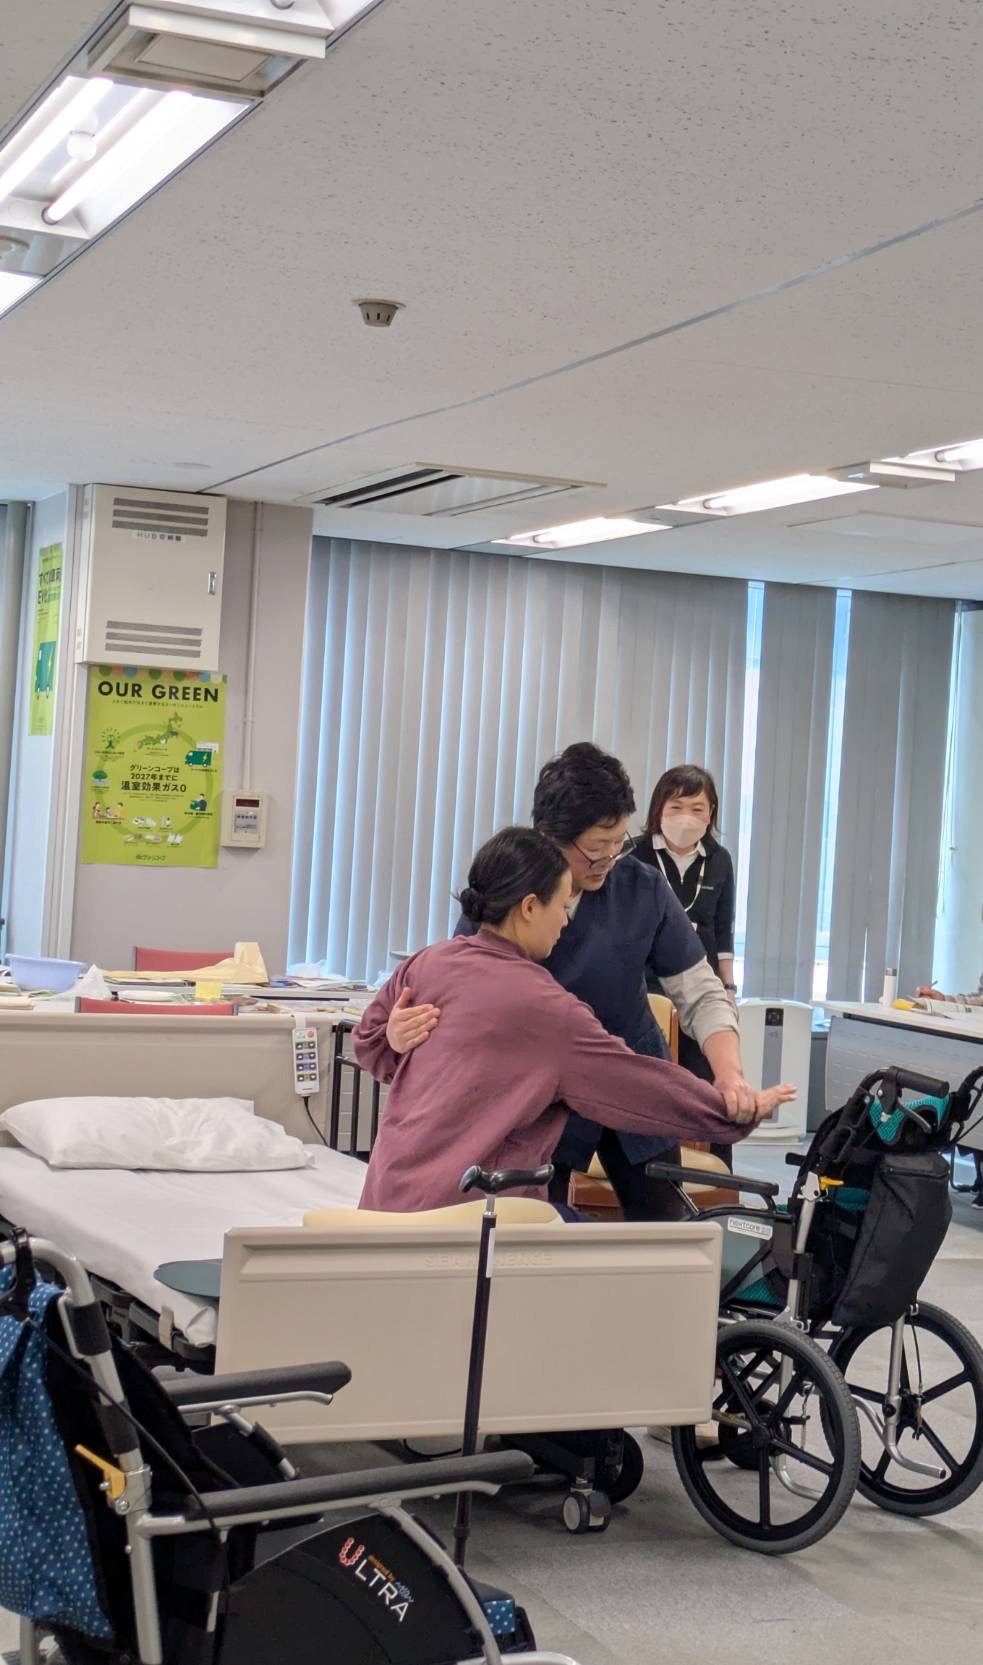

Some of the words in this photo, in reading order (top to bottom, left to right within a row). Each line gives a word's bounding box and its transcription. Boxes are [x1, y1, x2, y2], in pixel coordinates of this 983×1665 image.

[98, 681, 142, 698] OUR
[151, 684, 219, 702] GREEN
[129, 764, 180, 773] グリーンコープは
[130, 772, 179, 781] 2027年までに
[339, 1537, 409, 1622] ULTRA
